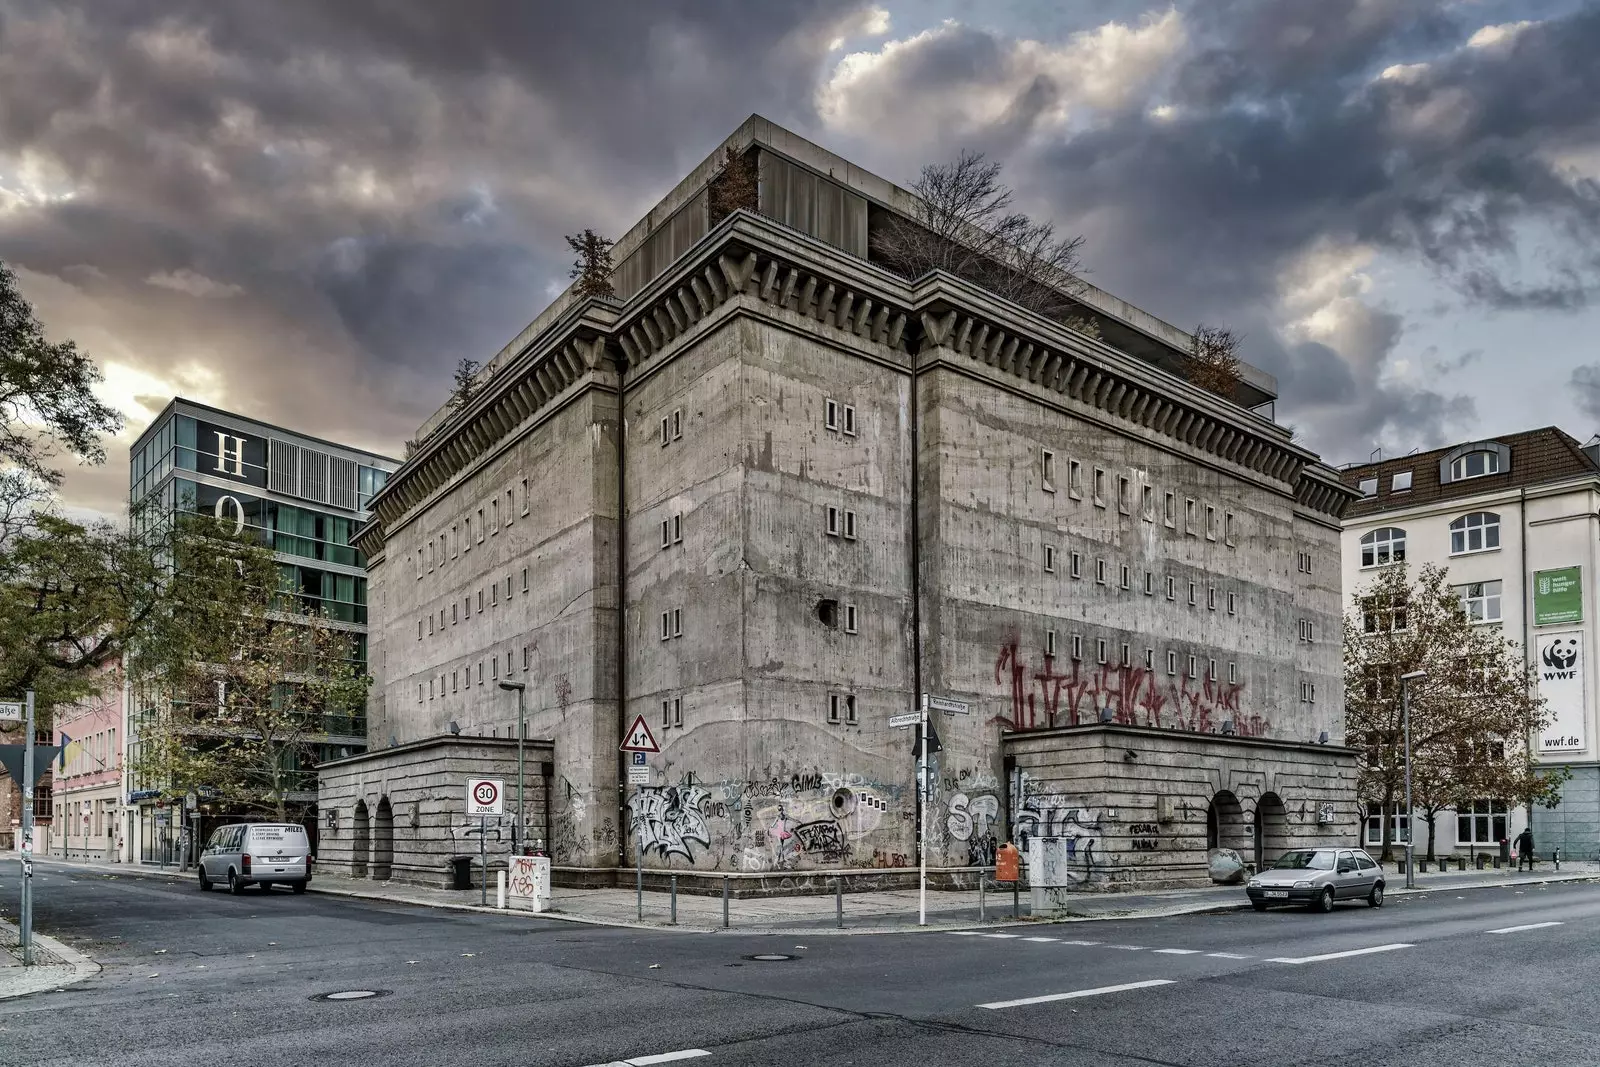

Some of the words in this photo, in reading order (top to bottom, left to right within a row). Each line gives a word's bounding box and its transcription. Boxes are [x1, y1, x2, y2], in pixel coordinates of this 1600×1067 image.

[1552, 580, 1576, 588] hunger
[1543, 671, 1577, 681] WWF
[932, 698, 966, 711] Reinhardtstraße
[890, 714, 921, 724] Albrechtstraße
[1544, 736, 1580, 747] wwf.de
[634, 753, 643, 764] P
[478, 787, 493, 799] 30
